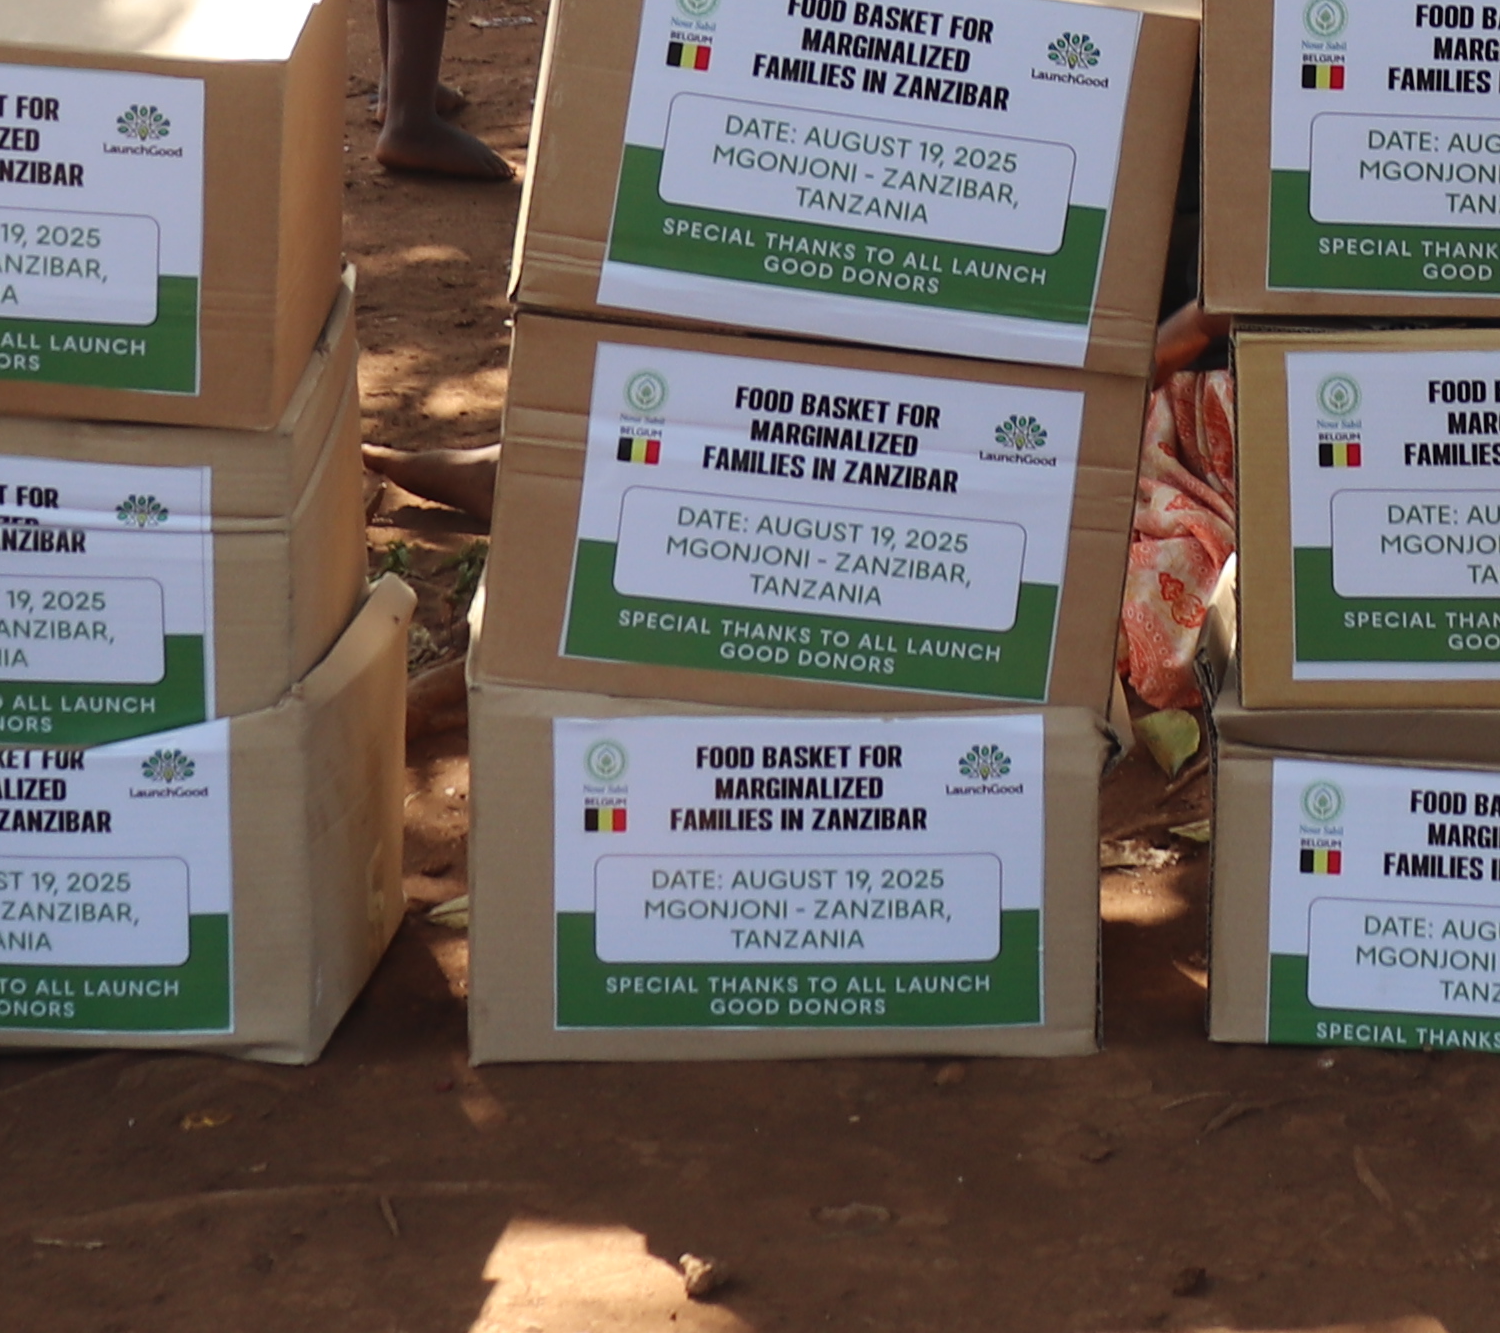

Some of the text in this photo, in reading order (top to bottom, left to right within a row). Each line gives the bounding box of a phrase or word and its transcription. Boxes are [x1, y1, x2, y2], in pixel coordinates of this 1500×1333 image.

[852, 1, 945, 37] BASKET
[948, 14, 995, 44] FOR
[1415, 4, 1476, 29] FOOD
[800, 27, 972, 73] MARGINALIZED
[751, 53, 1011, 111] FAMILIES IN ZANZIBAR
[1, 222, 28, 248] 19,
[35, 224, 102, 249] 2025
[617, 609, 1003, 662] SPECIAL THANKS TO ALL LAUNCH
[719, 642, 897, 675] GOOD DONORS
[946, 784, 1025, 796] LaunchGood
[652, 868, 945, 893] DATE: AUGUST 19, 2025
[730, 929, 865, 949] TANZANIA
[1364, 914, 1434, 939] DATE:
[35, 977, 75, 995] ALL
[83, 979, 180, 999] LAUNCH
